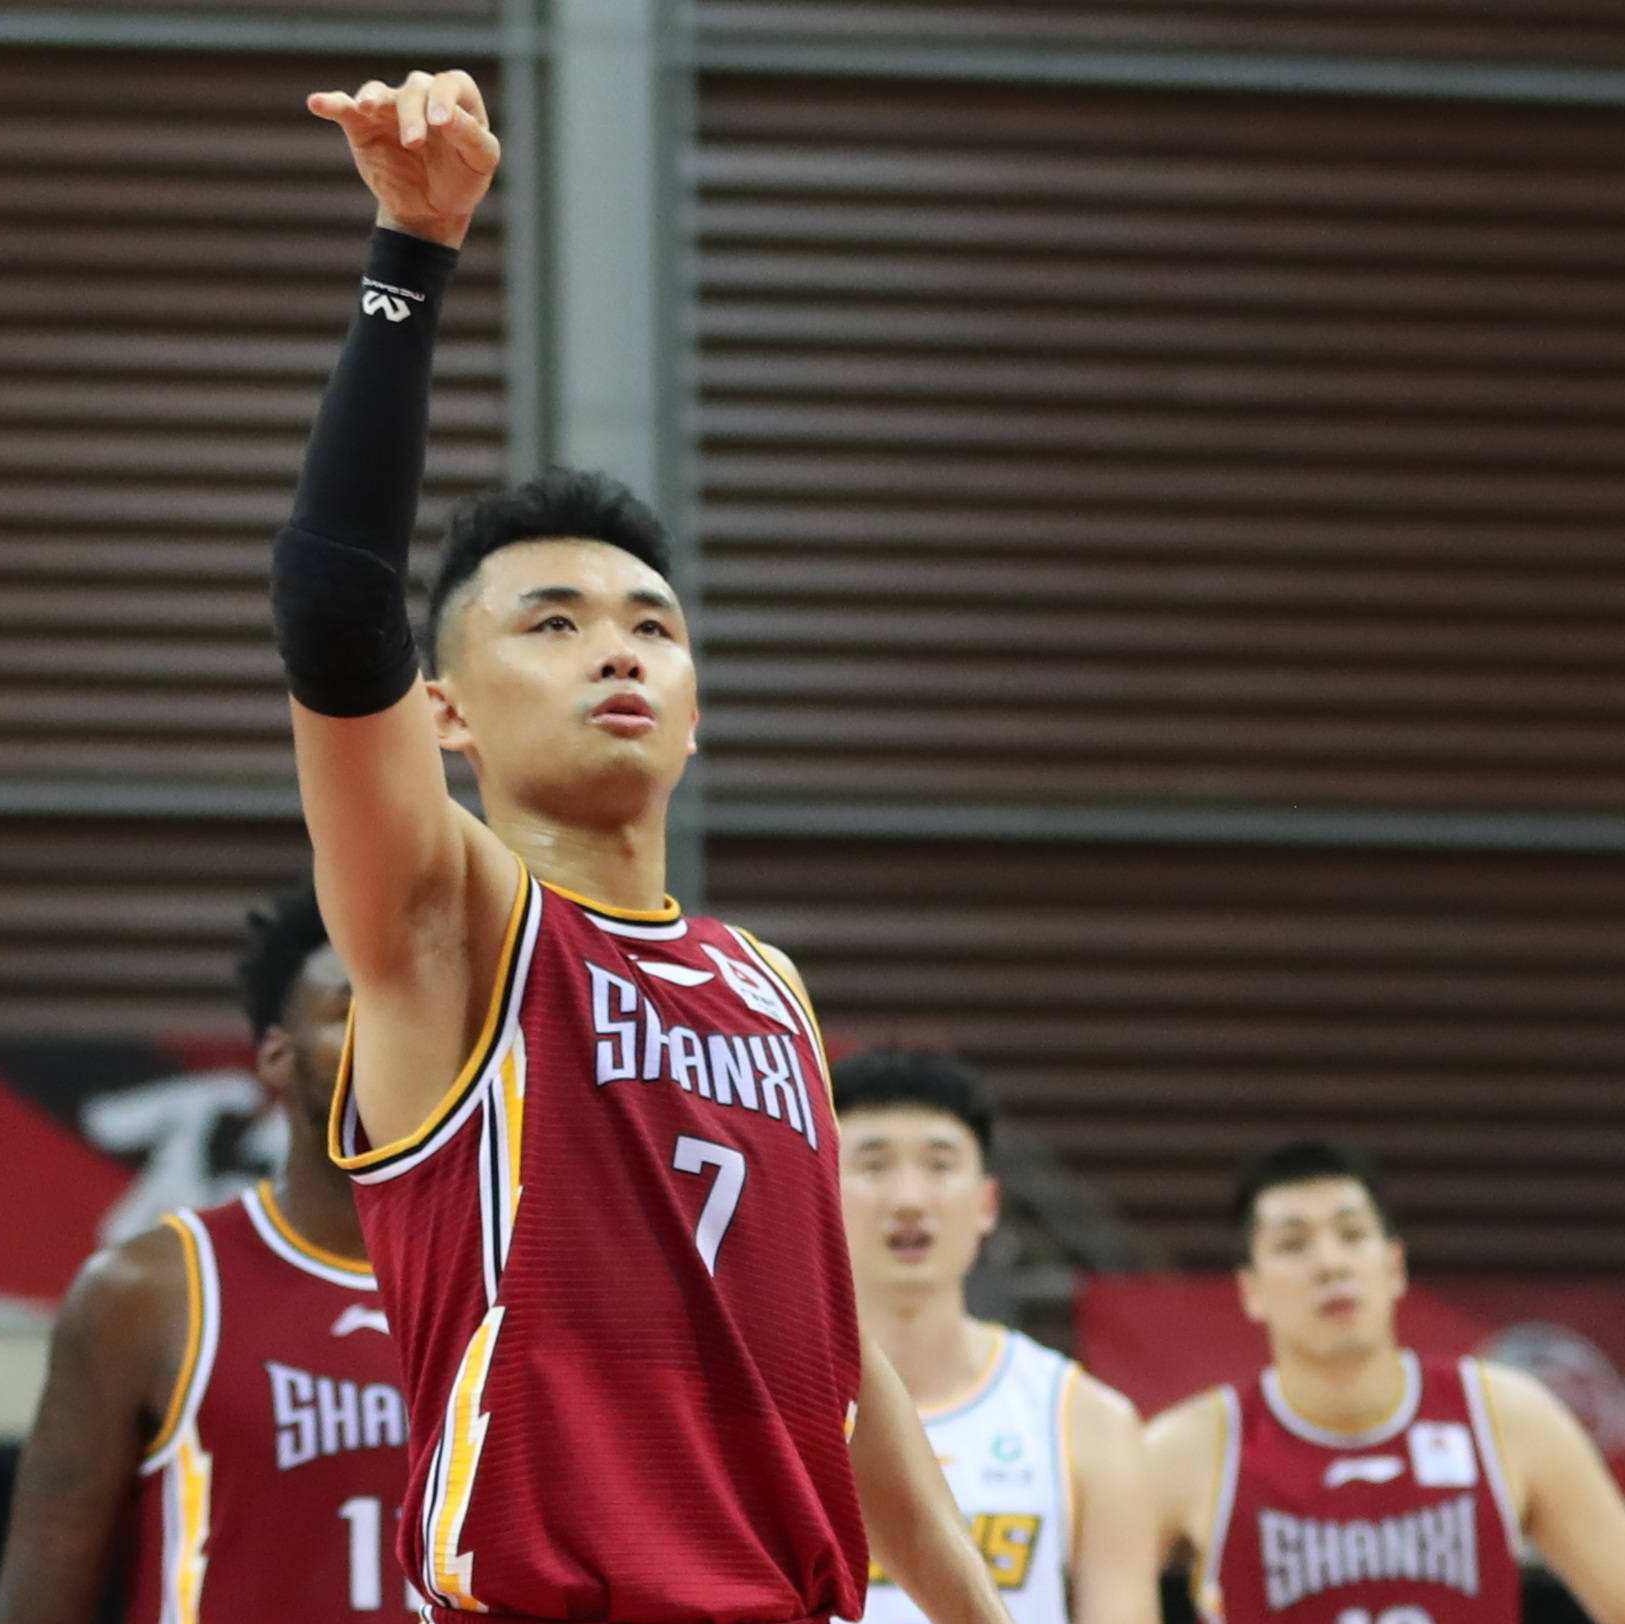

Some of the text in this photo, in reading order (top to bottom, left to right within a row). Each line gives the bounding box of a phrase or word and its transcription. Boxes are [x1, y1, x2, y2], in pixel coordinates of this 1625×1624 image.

[672, 1134, 747, 1279] 7
[266, 1358, 410, 1472] SHA
[1255, 1493, 1480, 1613] SHANXI
